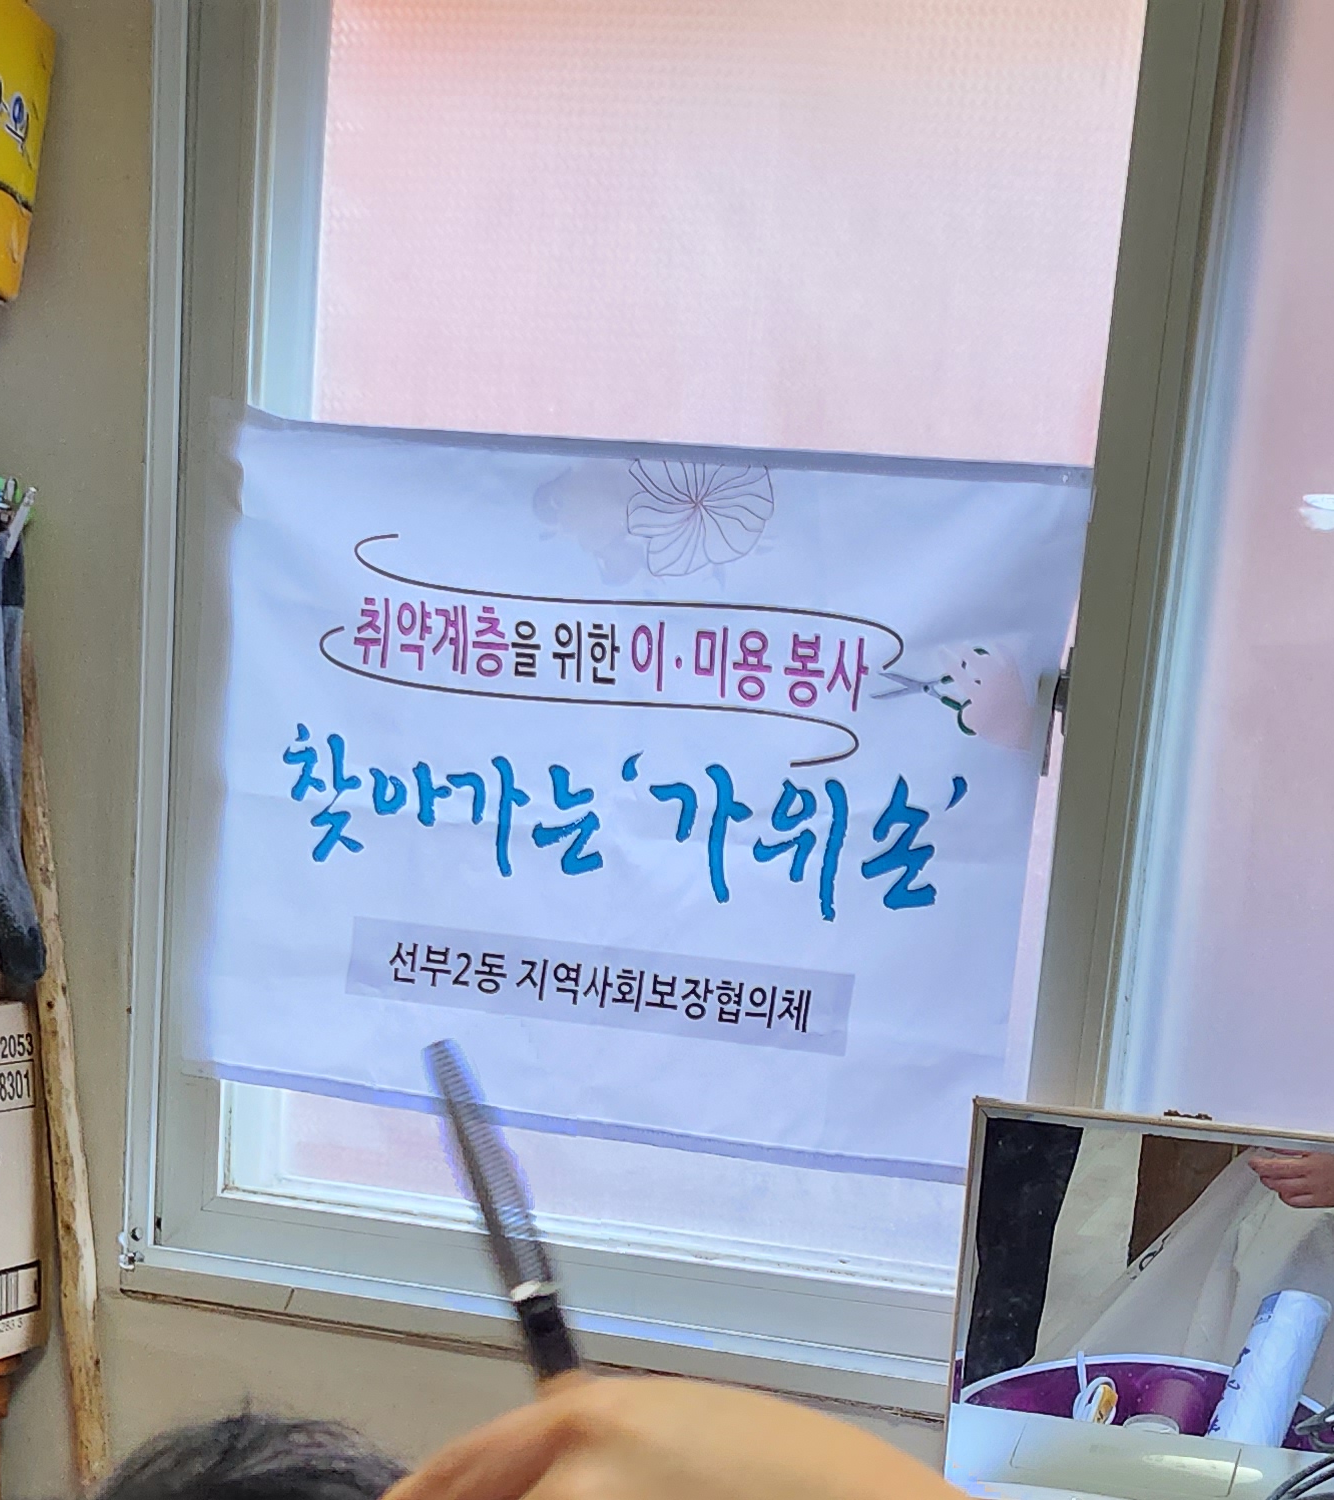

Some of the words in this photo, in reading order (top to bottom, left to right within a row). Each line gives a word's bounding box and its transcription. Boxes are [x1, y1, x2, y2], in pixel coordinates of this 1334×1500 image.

[353, 597, 542, 679] 취약계층을
[553, 621, 620, 685] 위한
[783, 633, 869, 711] 봉사
[282, 724, 605, 878] 찾아가는
[388, 941, 508, 995] 선부2동
[515, 958, 813, 1033] 지역사회보장협의체
